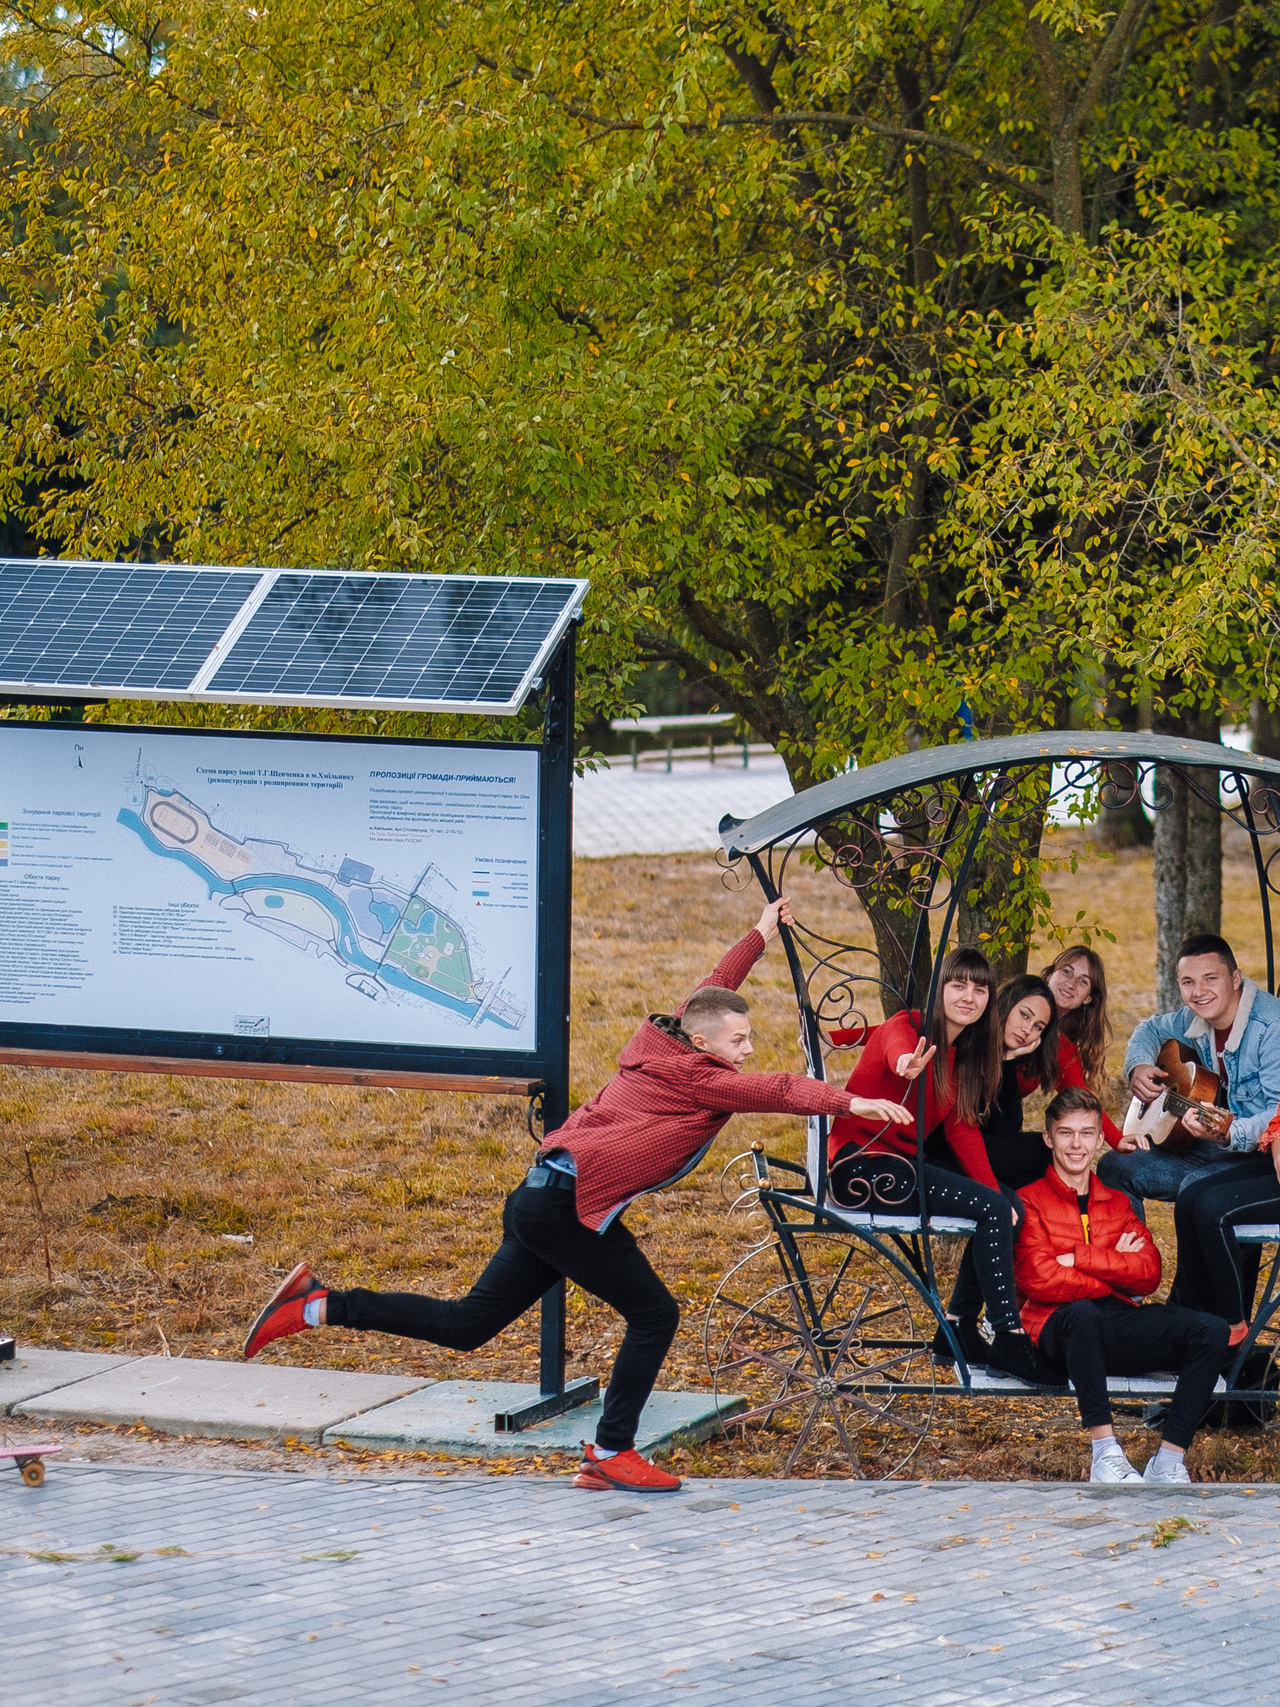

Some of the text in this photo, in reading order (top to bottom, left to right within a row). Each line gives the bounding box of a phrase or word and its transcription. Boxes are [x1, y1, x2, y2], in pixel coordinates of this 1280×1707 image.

[196, 767, 217, 775] Схема
[218, 769, 238, 778] парку
[239, 769, 256, 777] імені
[369, 771, 517, 784] ПРОПОЗИЦІЇ ГРОМАДИ-ПРИЙМАЮТЬСЯ!
